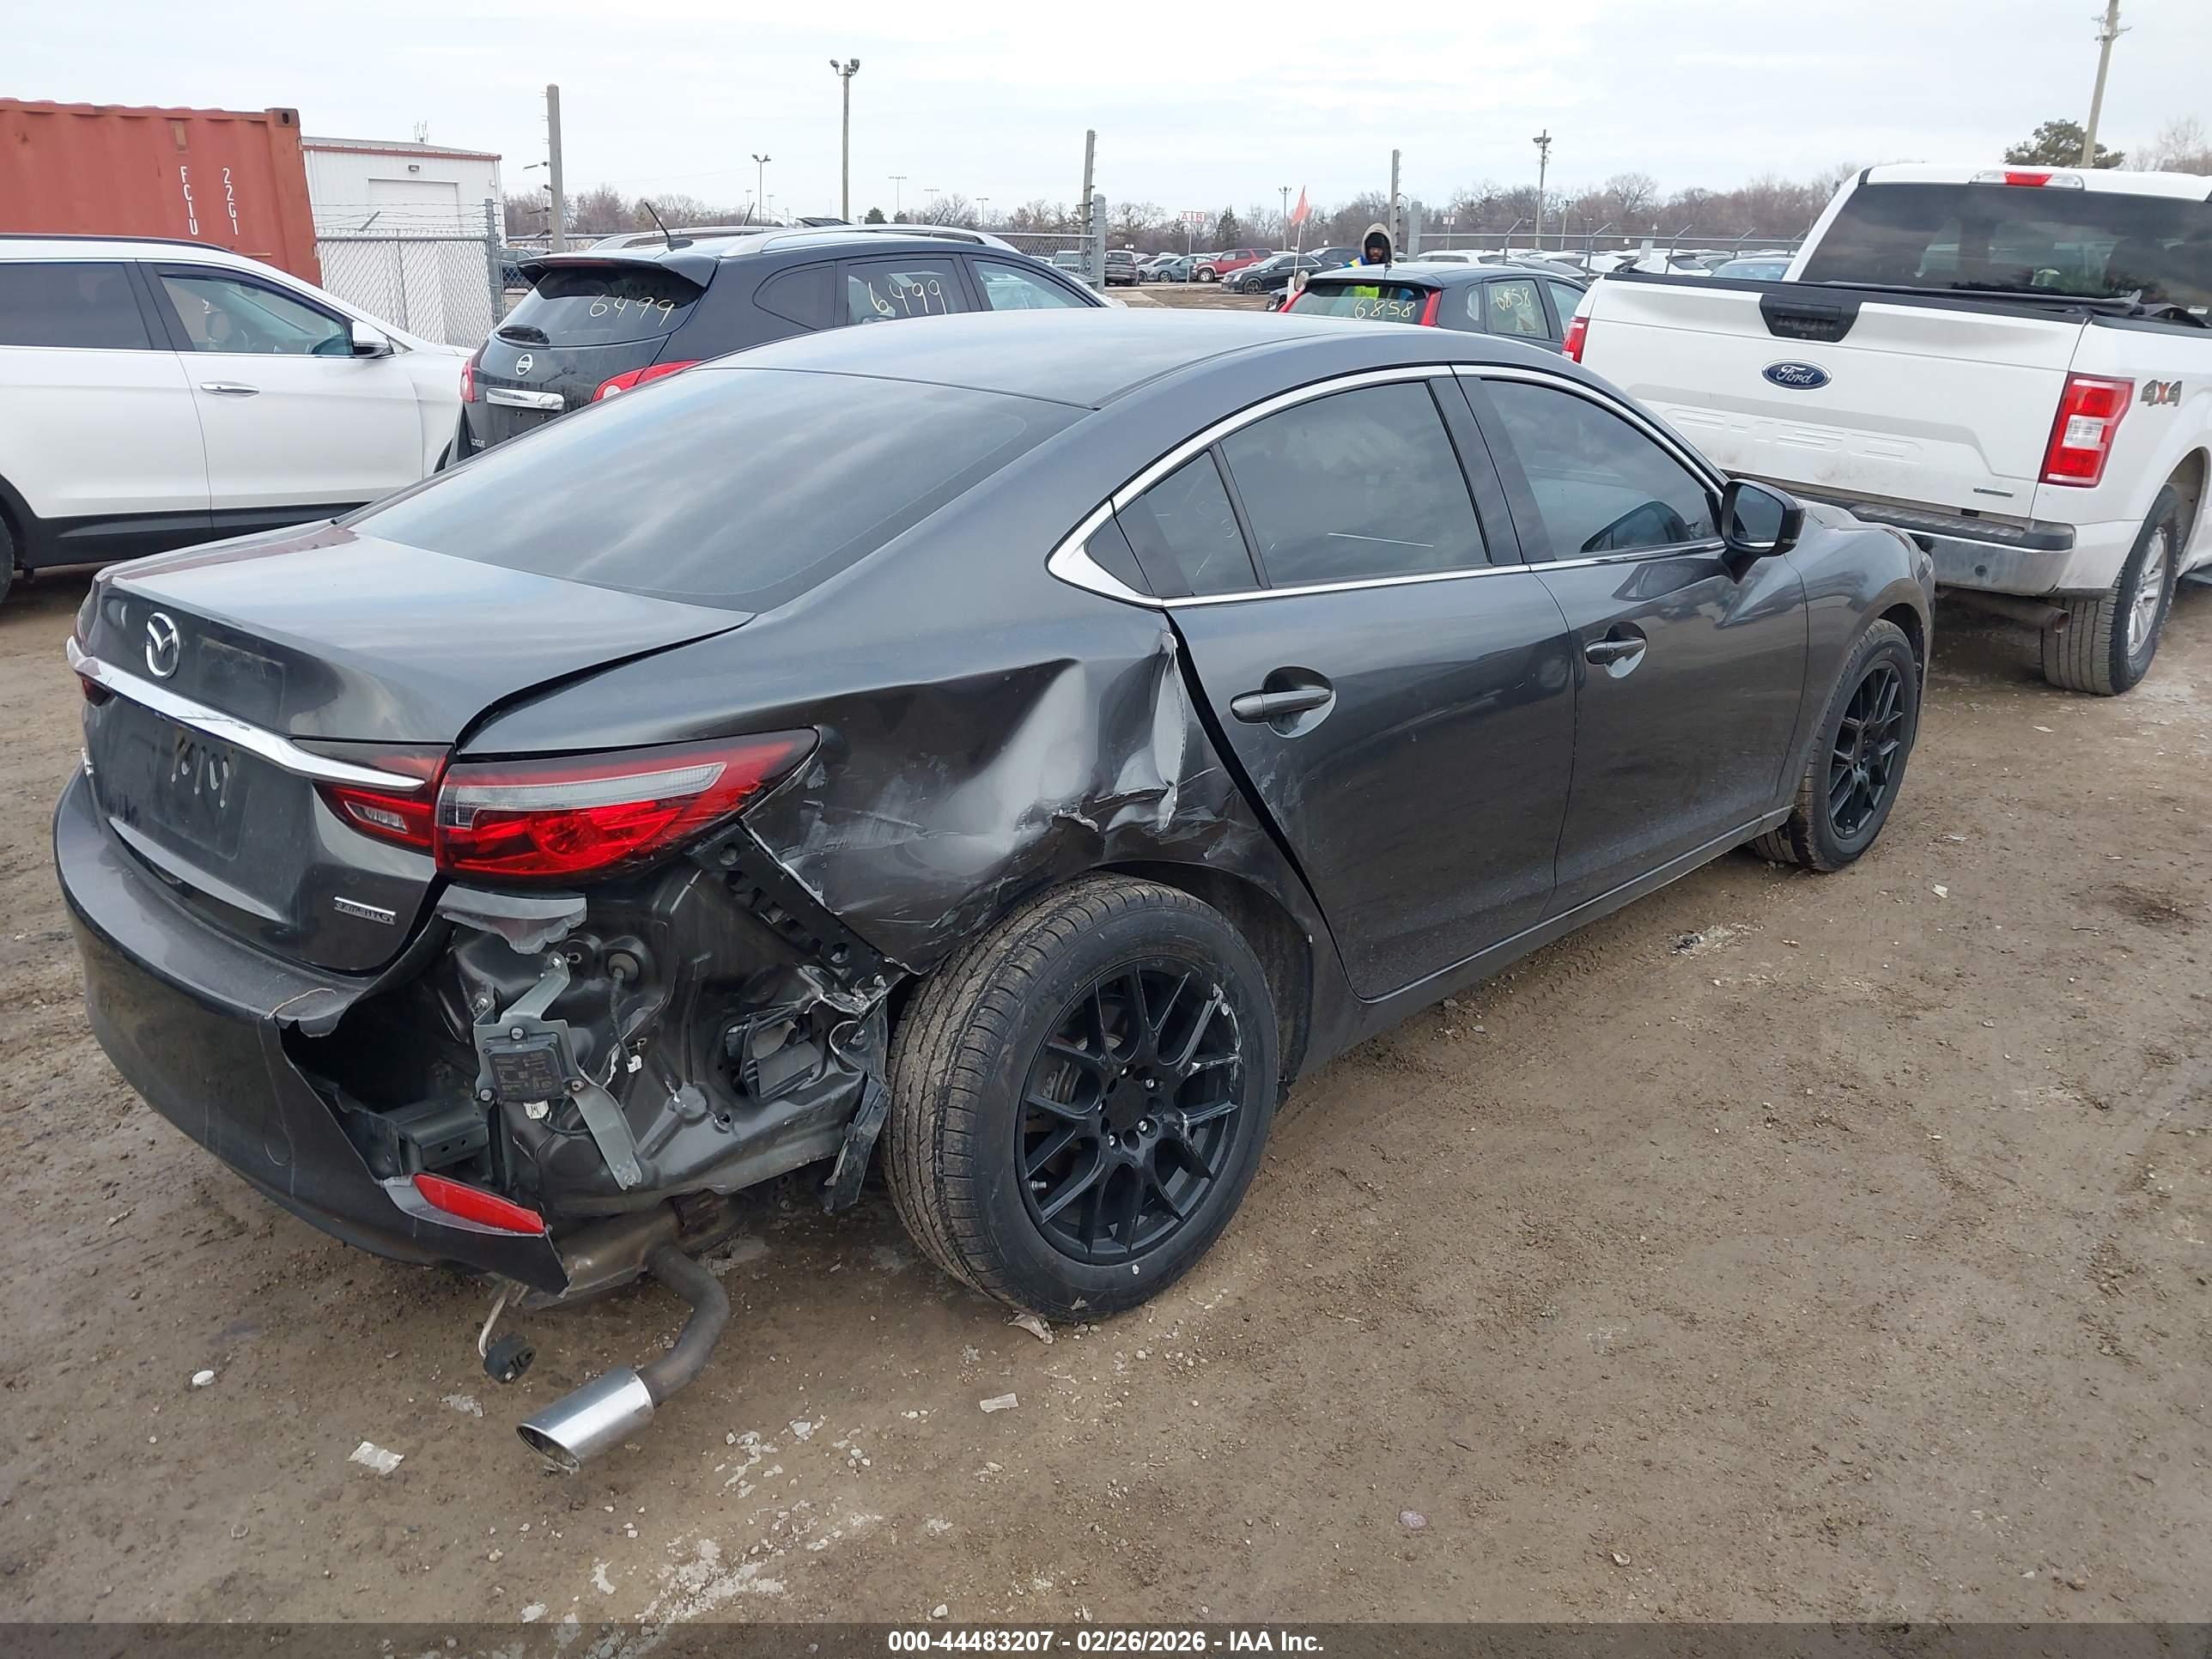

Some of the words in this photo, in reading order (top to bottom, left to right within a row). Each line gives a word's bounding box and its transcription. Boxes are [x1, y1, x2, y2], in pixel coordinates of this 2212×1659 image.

[179, 166, 198, 235] FCIU
[1195, 212, 1203, 222] B
[868, 279, 947, 315] 6499
[1495, 287, 1532, 311] 6858
[589, 294, 675, 327] 6499
[1354, 299, 1416, 320] 6858
[1776, 364, 1815, 385] Ford
